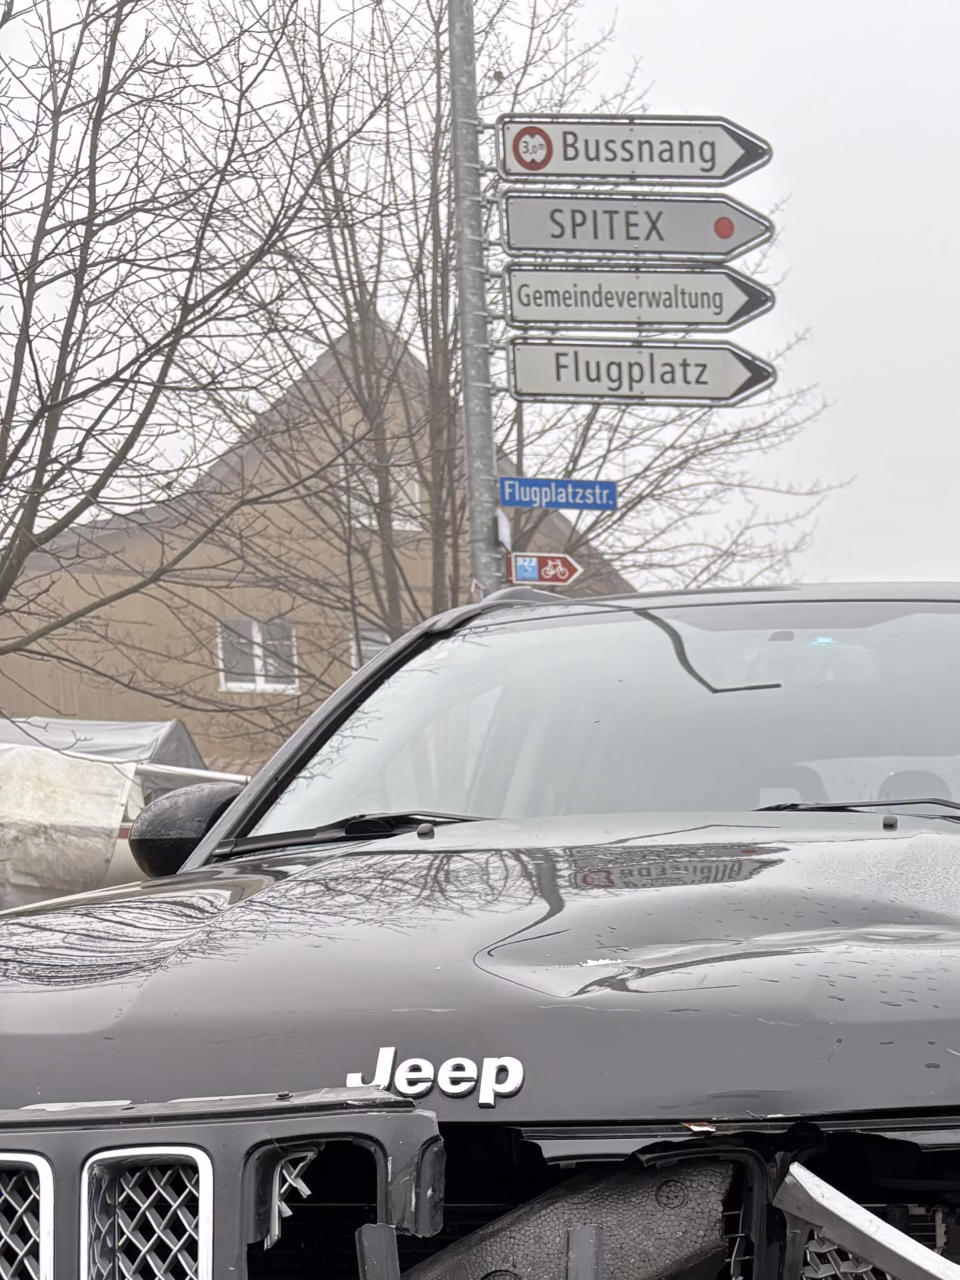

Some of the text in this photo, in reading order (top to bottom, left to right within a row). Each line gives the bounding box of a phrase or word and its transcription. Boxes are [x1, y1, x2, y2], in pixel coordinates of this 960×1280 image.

[562, 131, 716, 172] Bussnang
[549, 209, 665, 241] SPITEX
[517, 284, 724, 315] Gemeindeverwaltung
[555, 351, 709, 392] Flugplatz
[504, 481, 613, 507] Flugplatzstr.
[346, 1046, 524, 1109] Jeep
